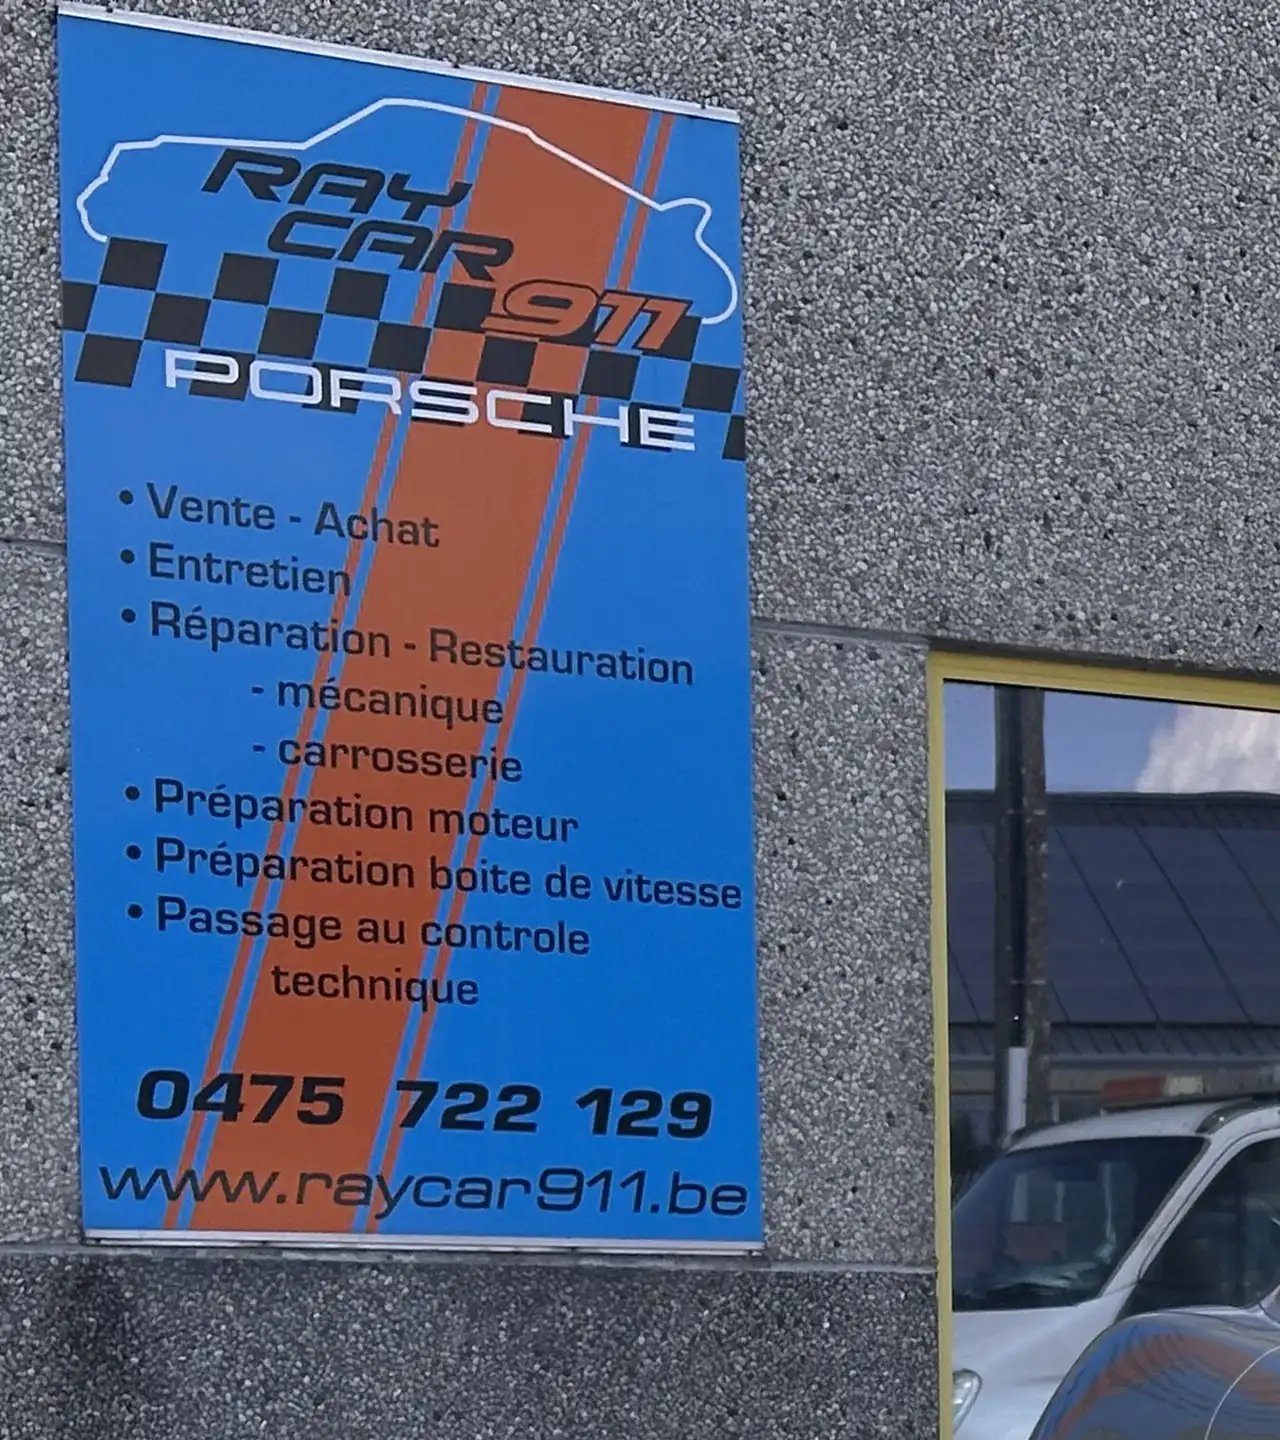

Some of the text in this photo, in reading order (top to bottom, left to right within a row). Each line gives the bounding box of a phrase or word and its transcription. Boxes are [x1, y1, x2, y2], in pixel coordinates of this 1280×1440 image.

[202, 148, 472, 222] RAY
[266, 210, 514, 281] CAR
[482, 278, 695, 351] 911
[163, 349, 695, 451] PORSCHE
[147, 482, 275, 530] Vente
[314, 502, 441, 549] Achat
[149, 543, 352, 597] Entretien
[151, 601, 391, 658] Réparation
[429, 627, 694, 685] Restauration
[277, 678, 505, 730] mécanique
[278, 738, 523, 782] carrosserie
[154, 777, 579, 842] Préparation moteur
[156, 836, 742, 910] Préparation boite de vitesse
[157, 894, 590, 956] Passage au controle
[271, 964, 478, 1015] technique
[136, 1069, 713, 1140] 0475 722 129
[100, 1165, 749, 1221] www.raycar911.be
